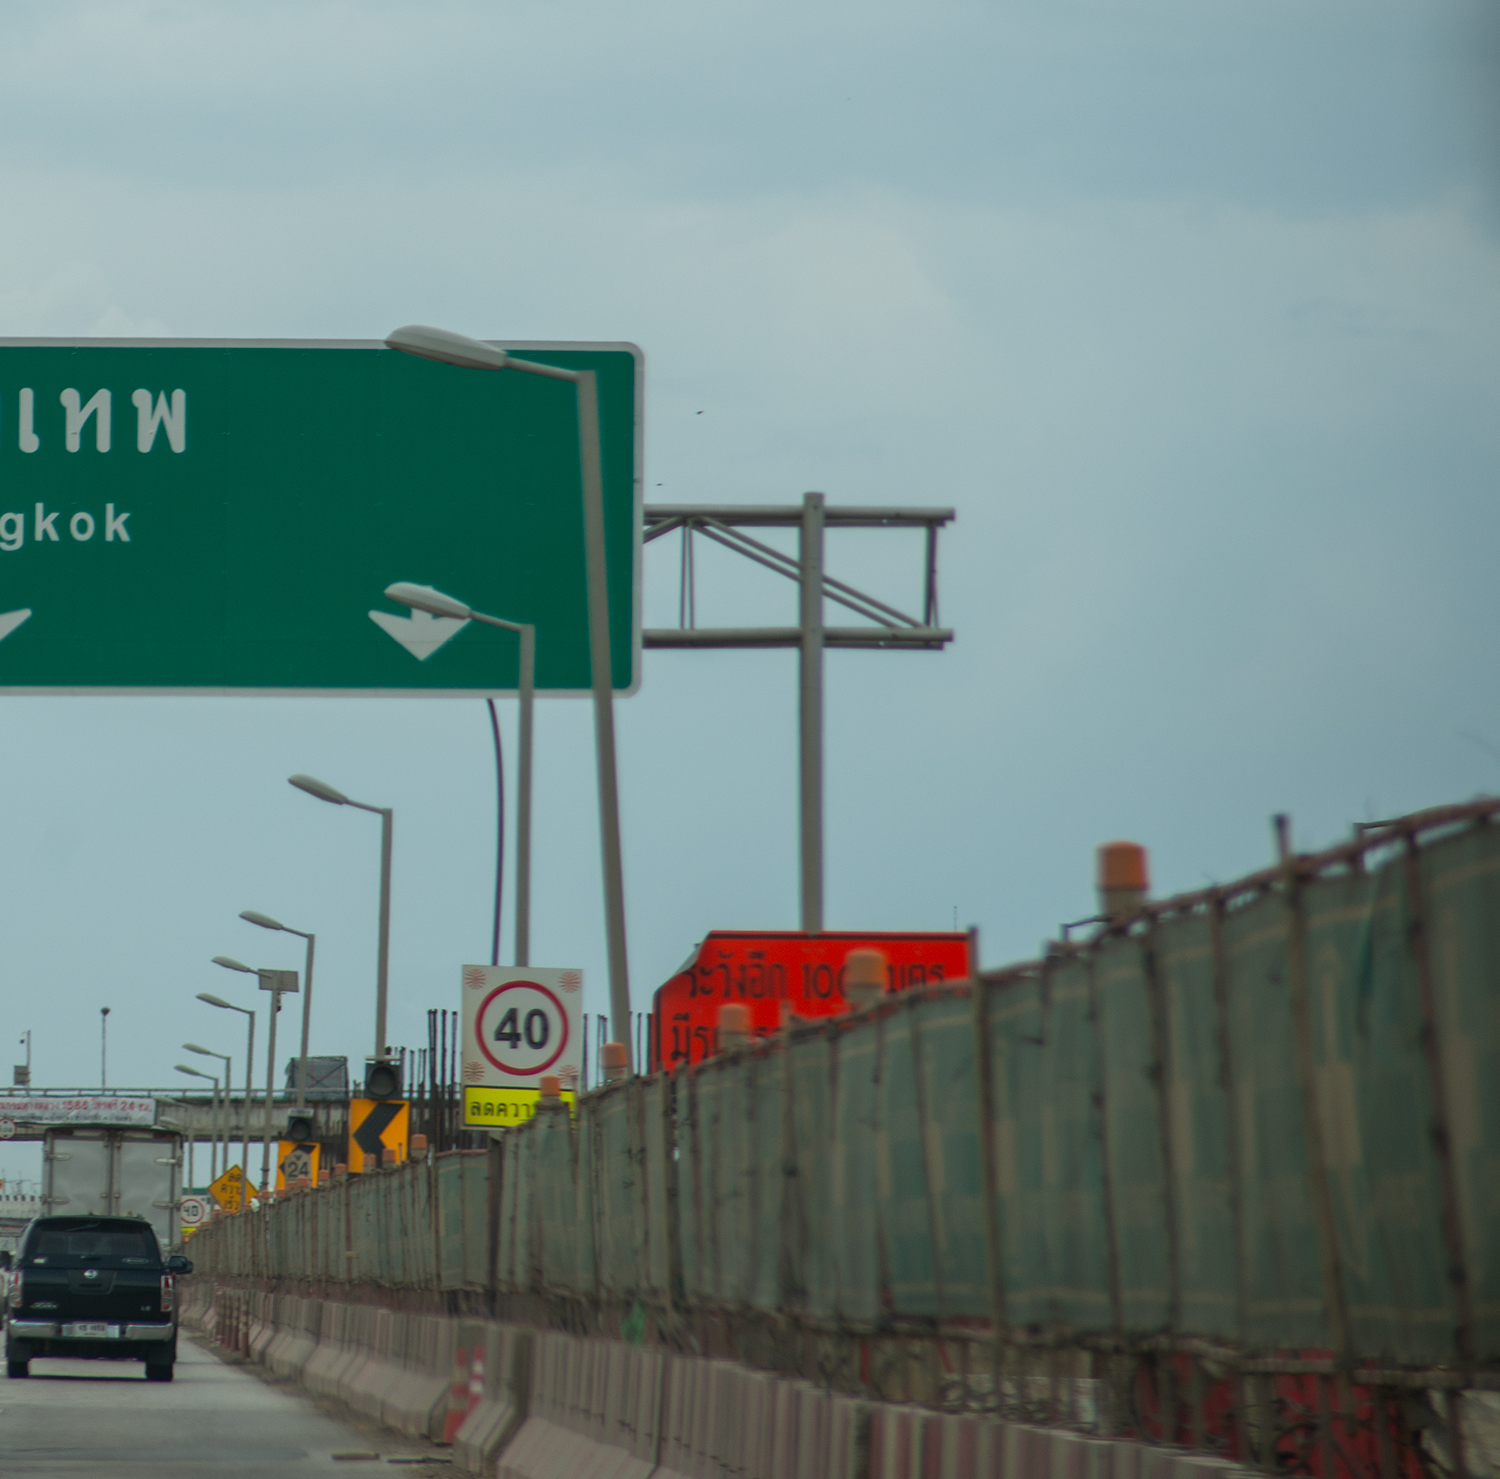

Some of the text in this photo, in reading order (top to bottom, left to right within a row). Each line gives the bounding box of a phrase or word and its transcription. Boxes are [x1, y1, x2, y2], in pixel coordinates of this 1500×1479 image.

[494, 1008, 549, 1050] 40
[471, 1101, 532, 1118] ลดควา
[287, 1162, 310, 1178] 24
[183, 1205, 199, 1217] 40
